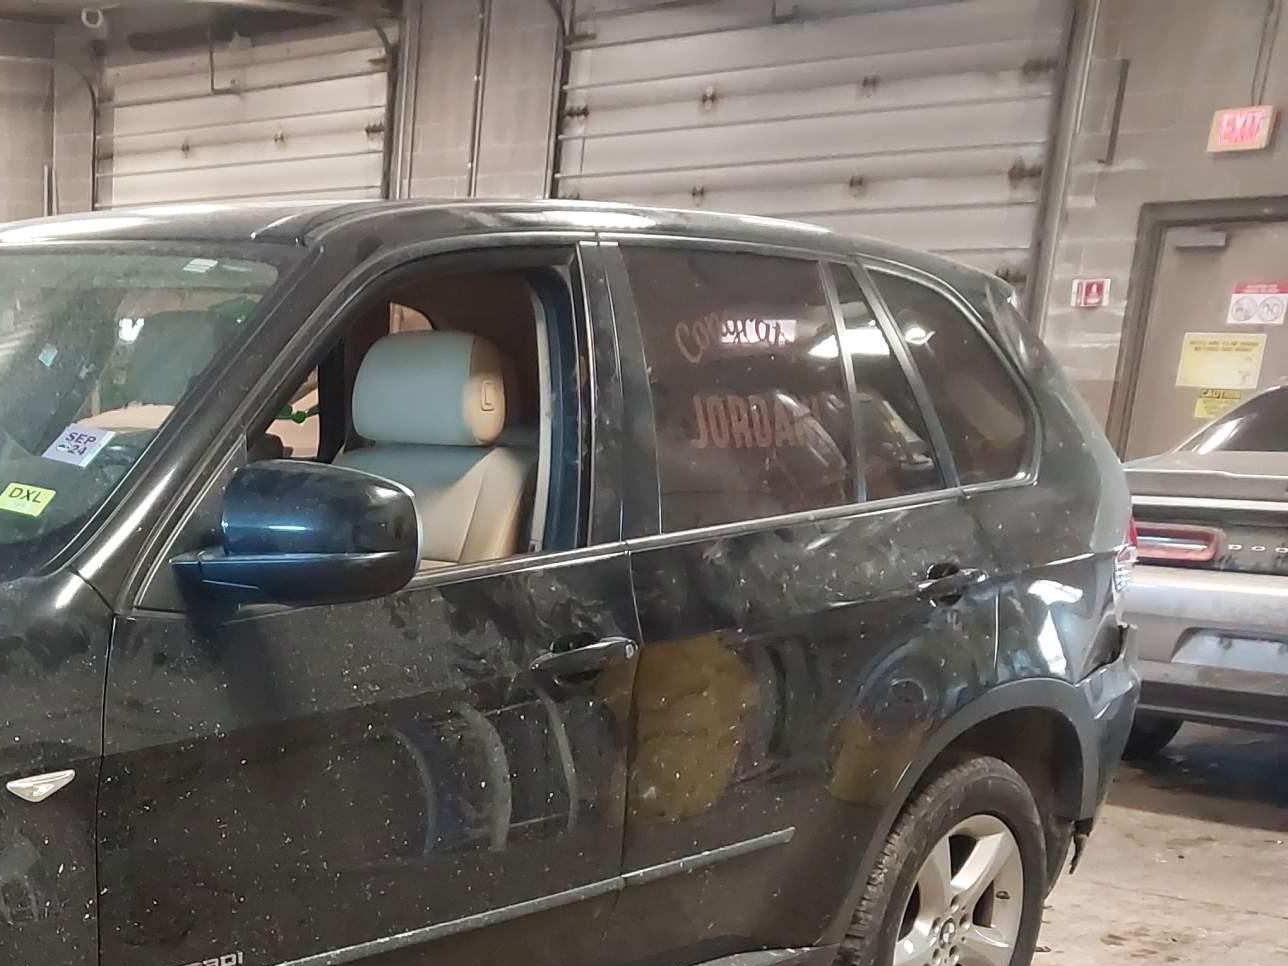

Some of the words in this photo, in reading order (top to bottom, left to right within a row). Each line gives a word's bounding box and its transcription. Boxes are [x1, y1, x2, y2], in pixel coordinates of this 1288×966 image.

[1219, 111, 1264, 144] EXIT
[66, 432, 97, 445] SEP
[8, 487, 42, 504] DXL
